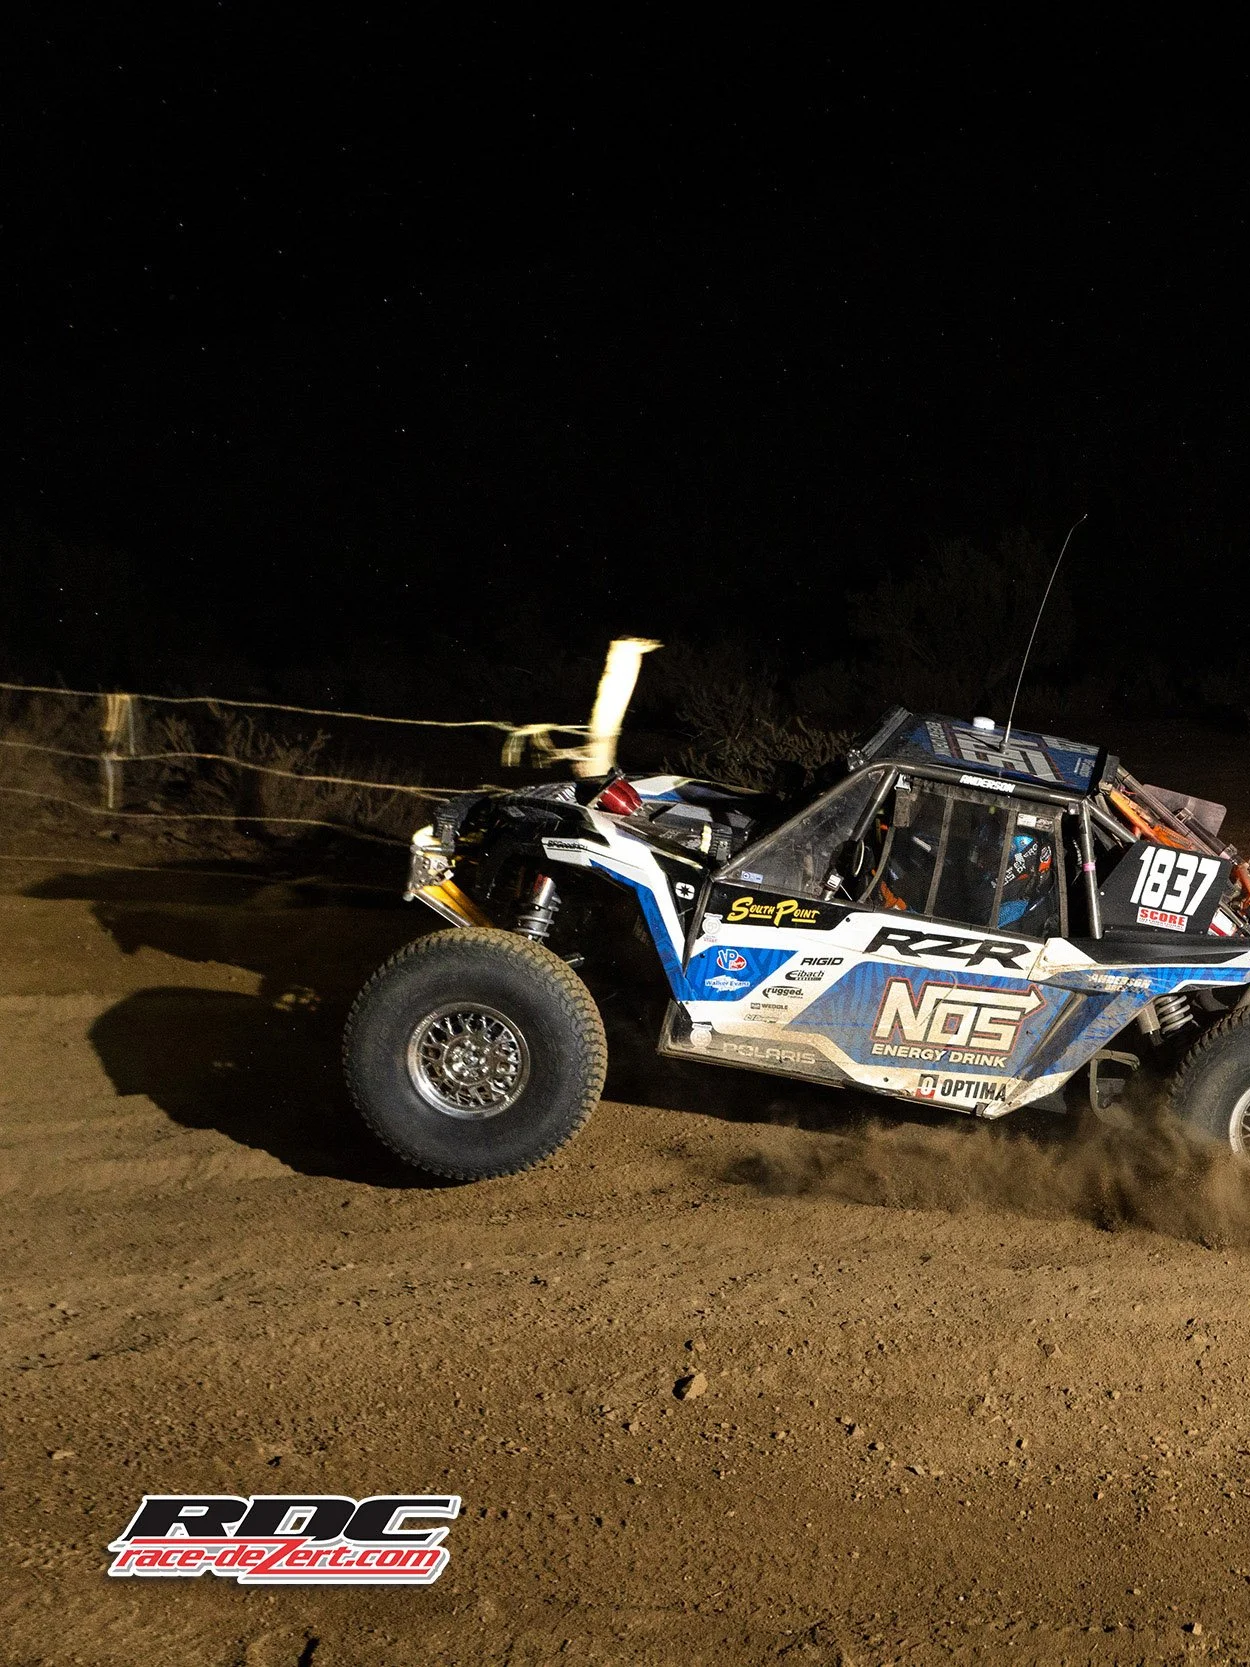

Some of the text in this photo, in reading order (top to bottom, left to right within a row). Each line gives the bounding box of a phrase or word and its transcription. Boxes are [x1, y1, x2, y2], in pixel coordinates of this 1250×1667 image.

[960, 775, 1016, 793] ANDERSON
[1130, 845, 1221, 916] 1837
[1140, 908, 1186, 926] SCORE
[717, 948, 739, 971] VP
[862, 926, 1032, 971] RZR
[800, 957, 844, 966] RIGID
[873, 979, 1045, 1052] NOS
[722, 1042, 816, 1064] POLARIS
[871, 1043, 1008, 1067] ENERGY DRINK
[940, 1077, 1007, 1102] OPTIMA
